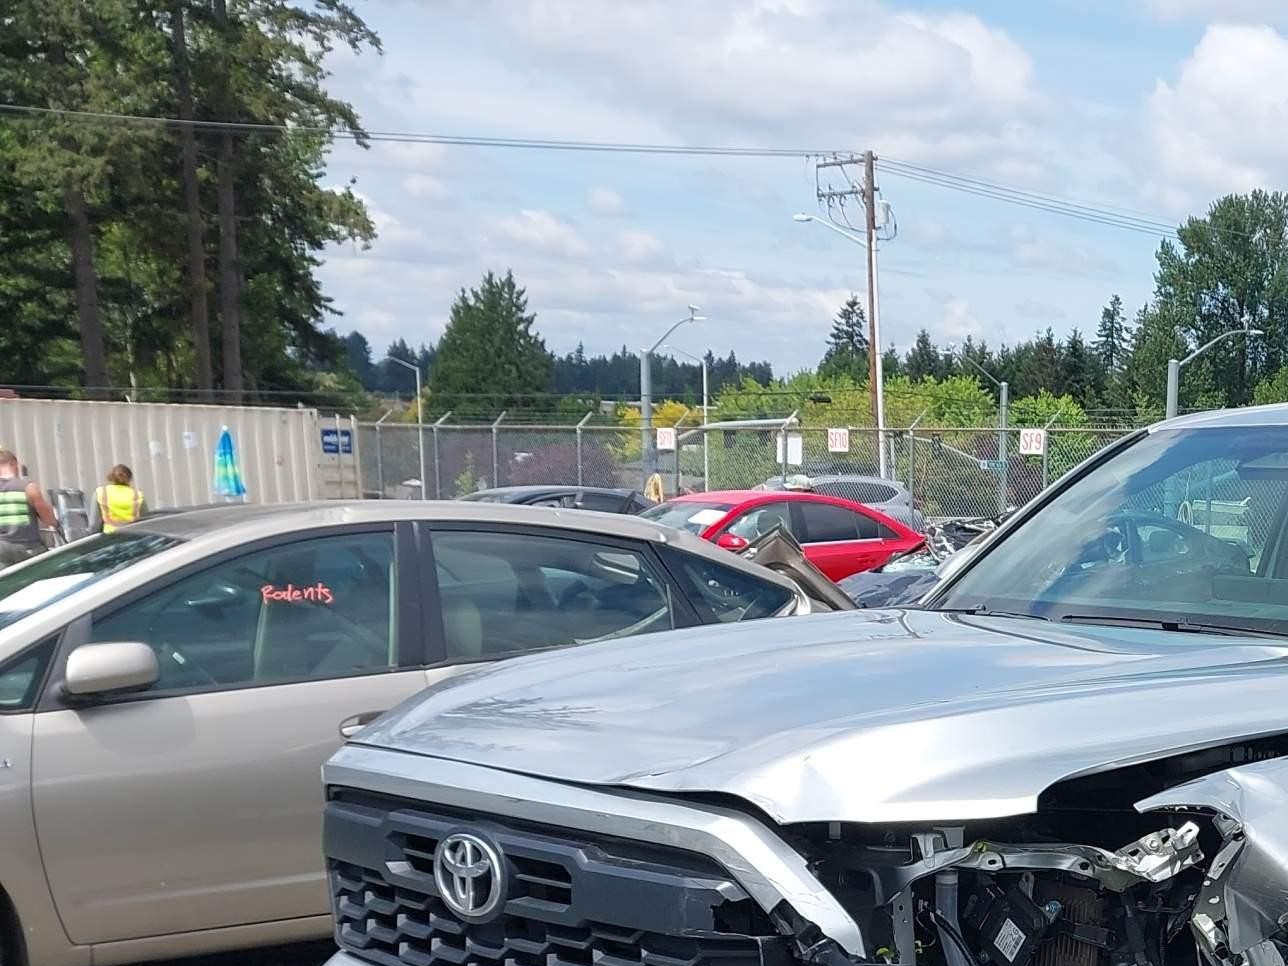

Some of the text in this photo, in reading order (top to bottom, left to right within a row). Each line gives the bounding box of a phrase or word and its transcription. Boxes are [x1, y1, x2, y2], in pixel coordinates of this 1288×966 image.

[830, 432, 847, 448] SF10
[1022, 432, 1042, 450] SF9
[261, 582, 334, 604] Rodents
